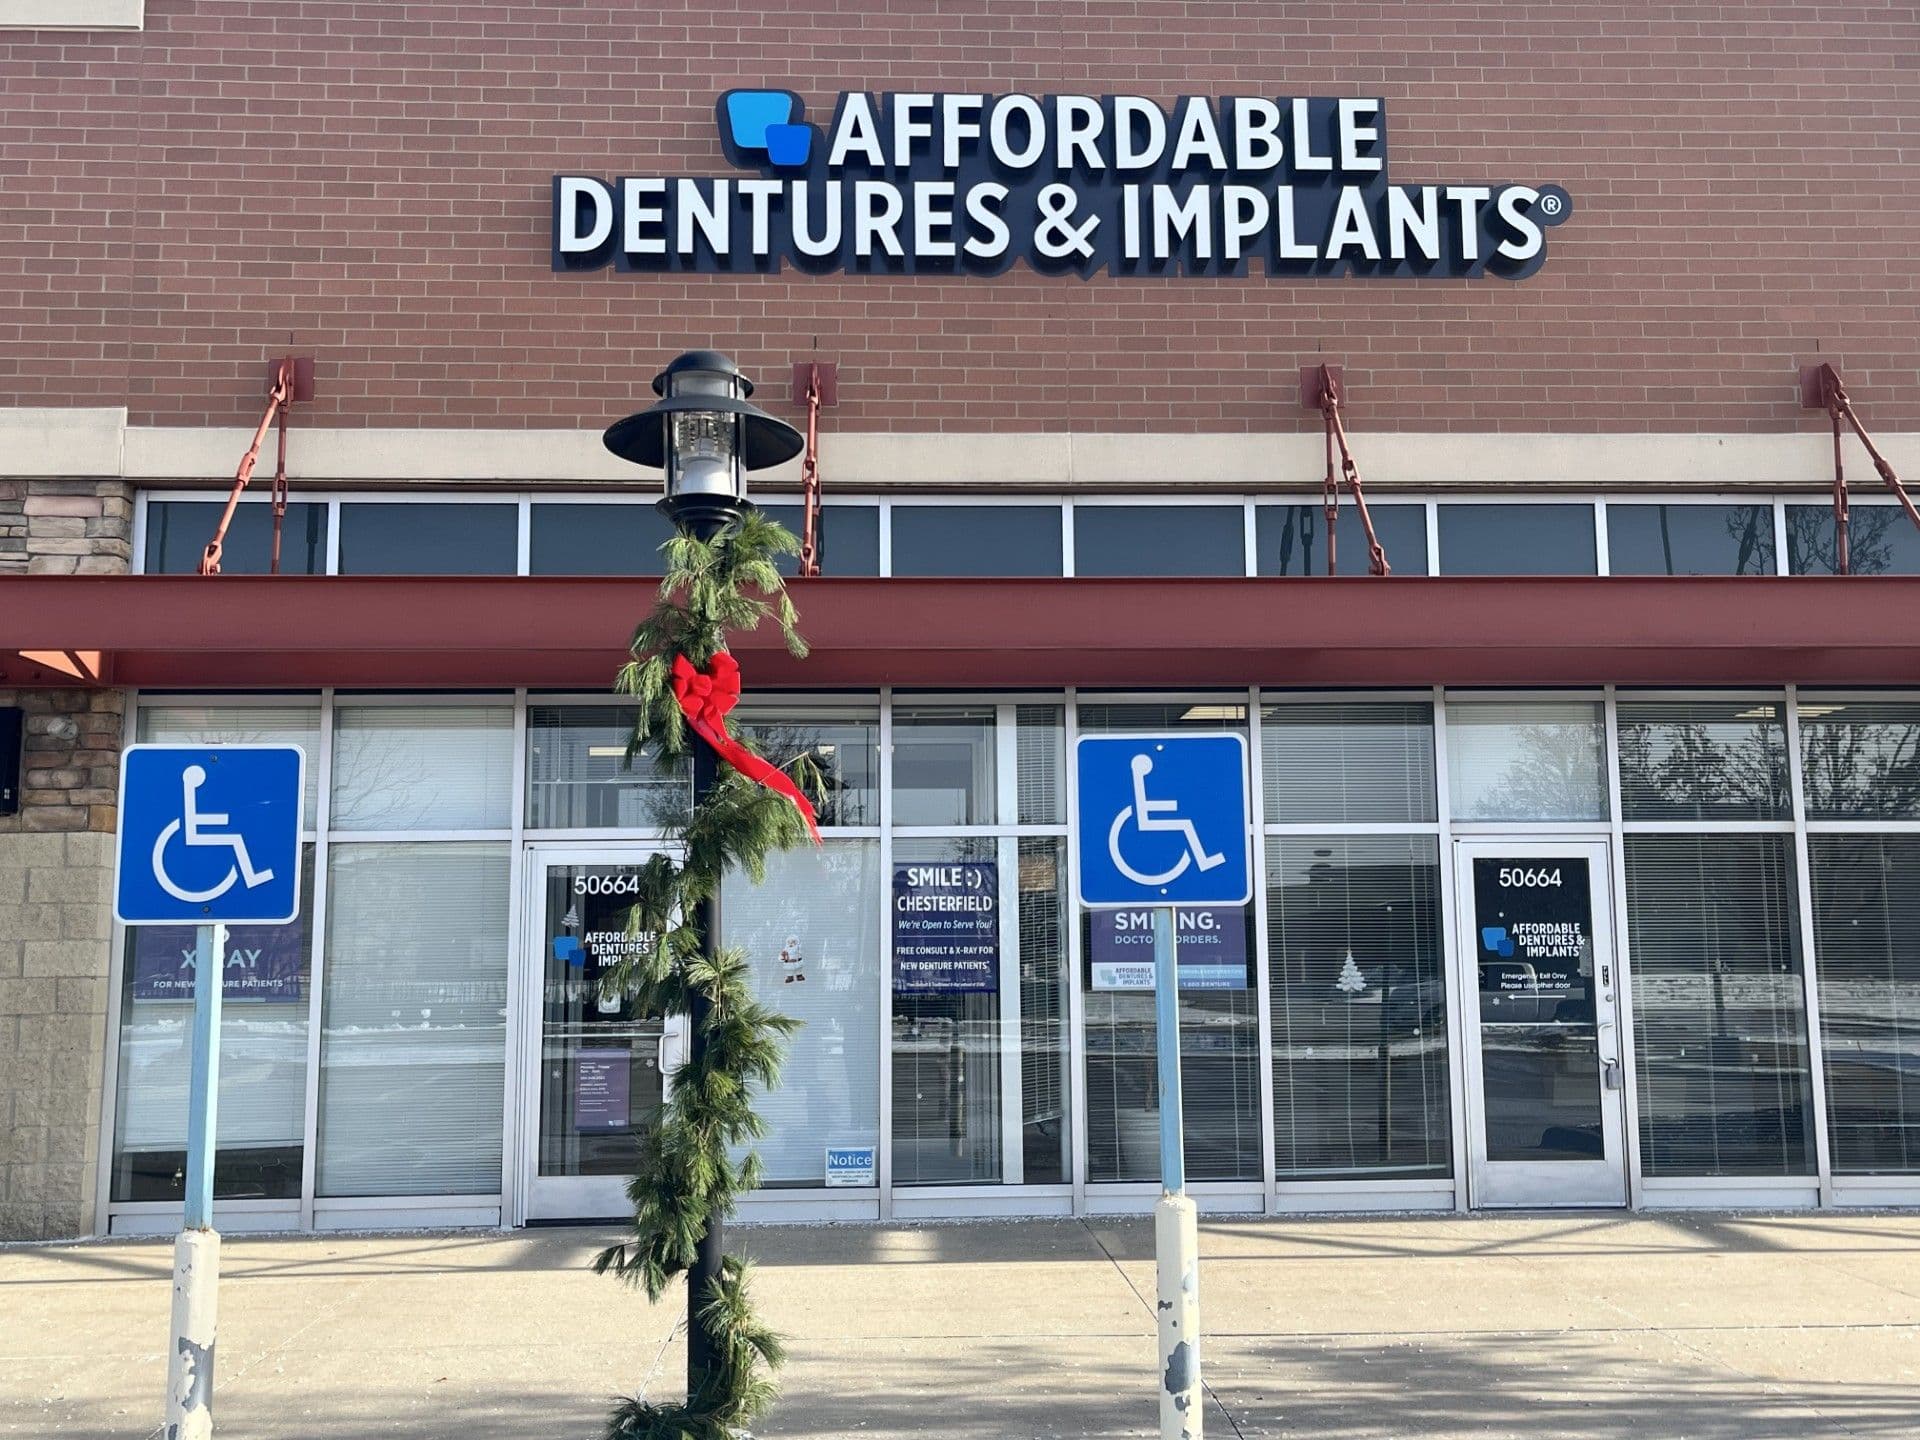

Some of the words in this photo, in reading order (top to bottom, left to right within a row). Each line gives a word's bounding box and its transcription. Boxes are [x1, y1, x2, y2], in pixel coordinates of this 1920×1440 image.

[828, 92, 1383, 171] AFFORDABLE
[558, 176, 1011, 259] DENTURES
[1033, 182, 1101, 259] &
[906, 867, 962, 888] SMILE
[1498, 868, 1563, 888] 50664
[573, 875, 640, 895] 50664
[897, 895, 993, 912] CHESTERFIELD
[898, 919, 921, 930] We're
[921, 919, 943, 931] Open
[943, 919, 952, 930] to
[953, 919, 975, 930] Serve
[976, 919, 993, 930] You!
[1115, 911, 1222, 930] SMING.
[1511, 923, 1581, 935] AFFORDABLE
[584, 931, 657, 944] AFFORDBLE
[1518, 935, 1575, 946] DENTURES
[1576, 936, 1586, 947] &
[591, 943, 650, 956] DENTURES
[896, 946, 915, 956] FREE
[915, 946, 948, 956] CONSULT
[948, 946, 955, 955] &
[955, 946, 978, 955] X-RAY
[978, 946, 994, 955] FOR
[900, 961, 919, 971] NEW
[919, 961, 953, 970] DENTURE
[153, 980, 173, 989] FOR
[174, 980, 196, 988] NEW
[241, 979, 284, 988] PATIENTS
[828, 1154, 873, 1166] Notice
